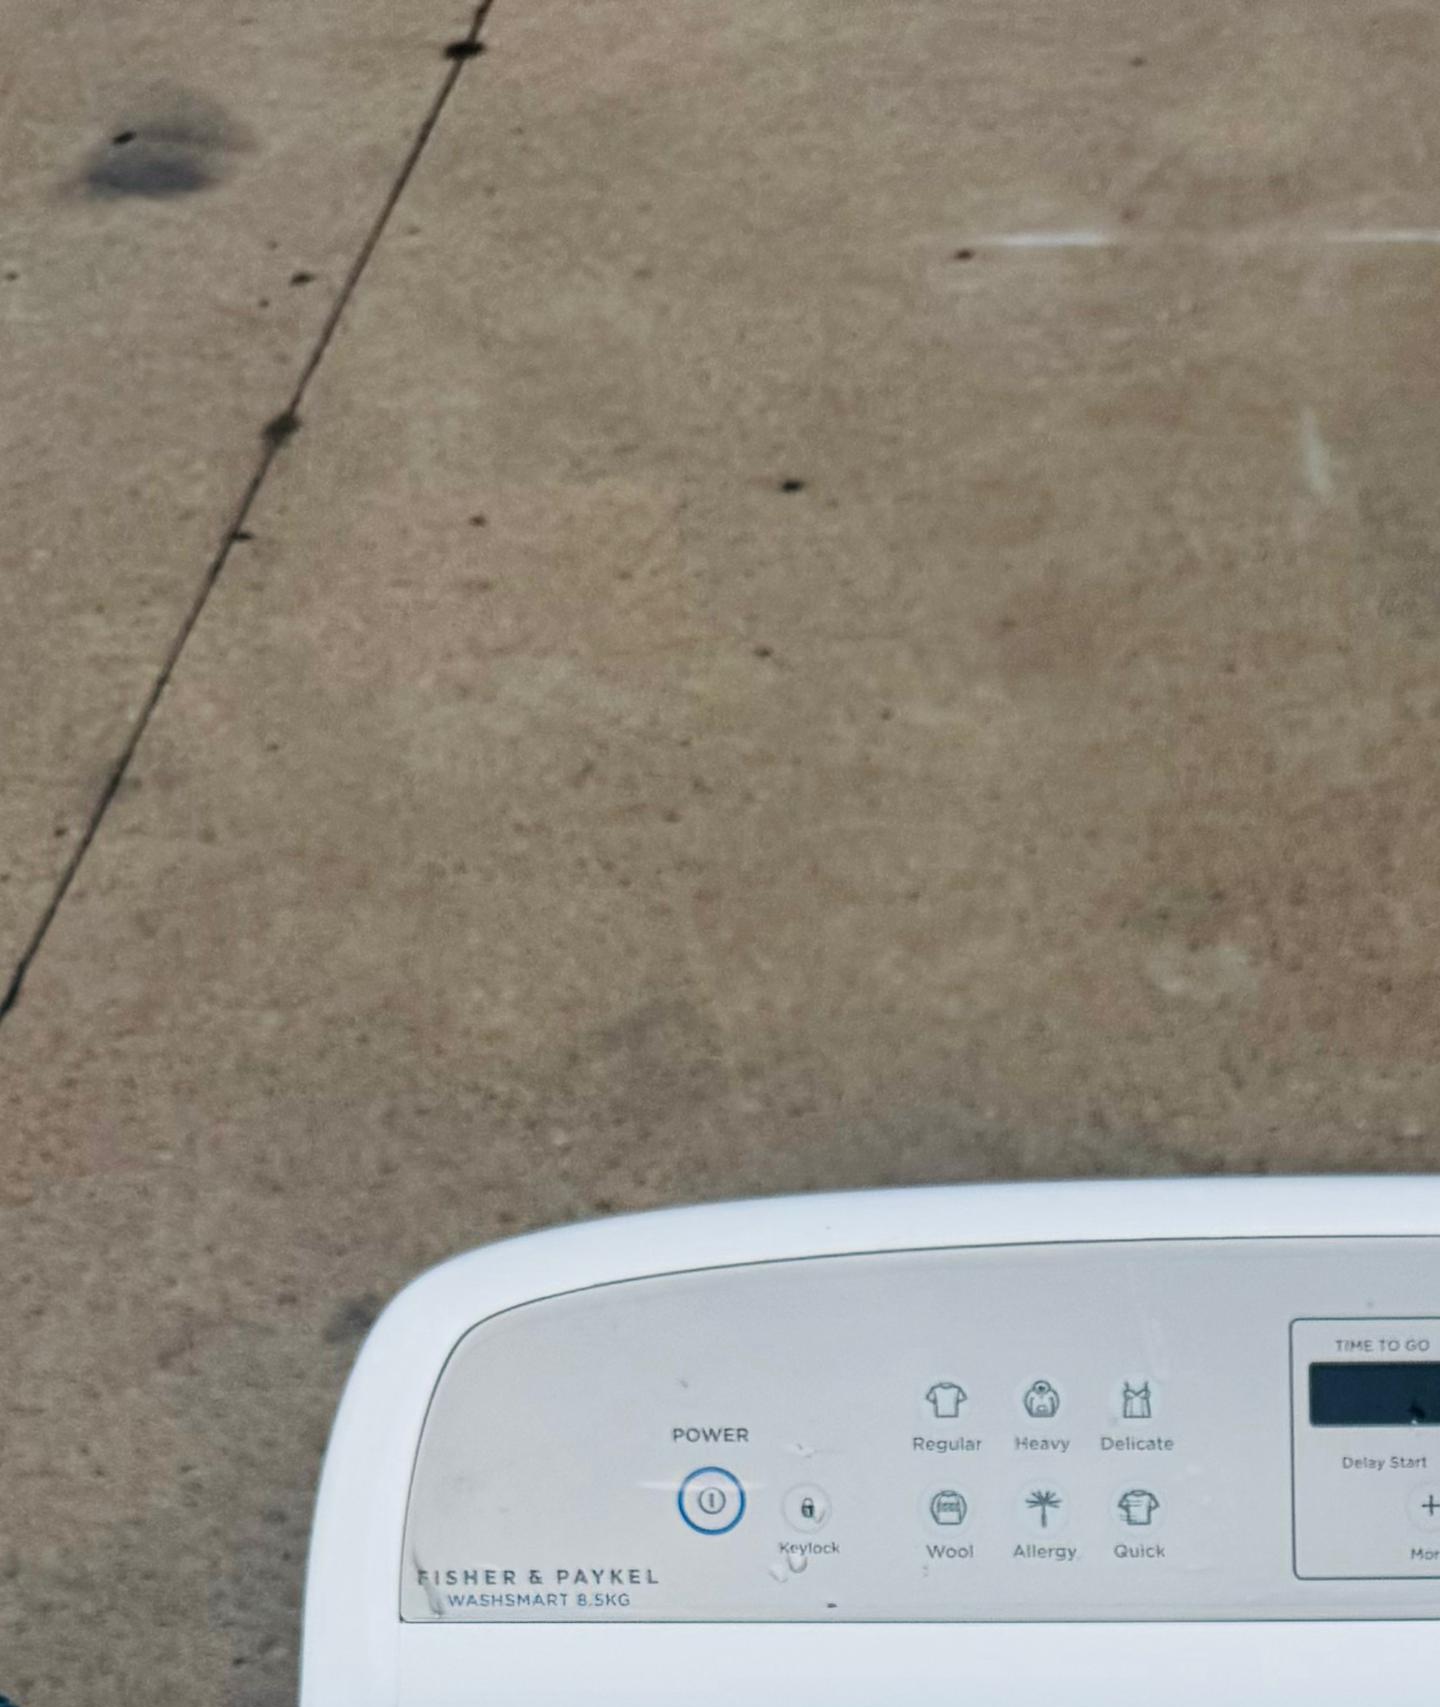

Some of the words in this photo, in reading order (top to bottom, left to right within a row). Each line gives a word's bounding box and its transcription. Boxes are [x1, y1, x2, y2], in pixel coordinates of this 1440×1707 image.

[1335, 1339, 1373, 1352] TIME
[1379, 1339, 1400, 1352] TO
[1405, 1339, 1430, 1352] GO
[672, 1428, 749, 1444] POWER
[1100, 1435, 1174, 1451] Delicate
[912, 1436, 982, 1453] Regular
[1015, 1436, 1070, 1453] Heavy
[1342, 1456, 1385, 1471] Delay
[1390, 1456, 1427, 1469] Start
[779, 1541, 840, 1556] Keylock
[926, 1544, 974, 1559] Wool
[1013, 1544, 1077, 1562] Allergy
[1114, 1543, 1165, 1560] Quick
[529, 1570, 544, 1585] &
[556, 1569, 659, 1585] PAYKEL
[447, 1593, 568, 1607] WASHSMART
[577, 1593, 630, 1607] 8.5KG
